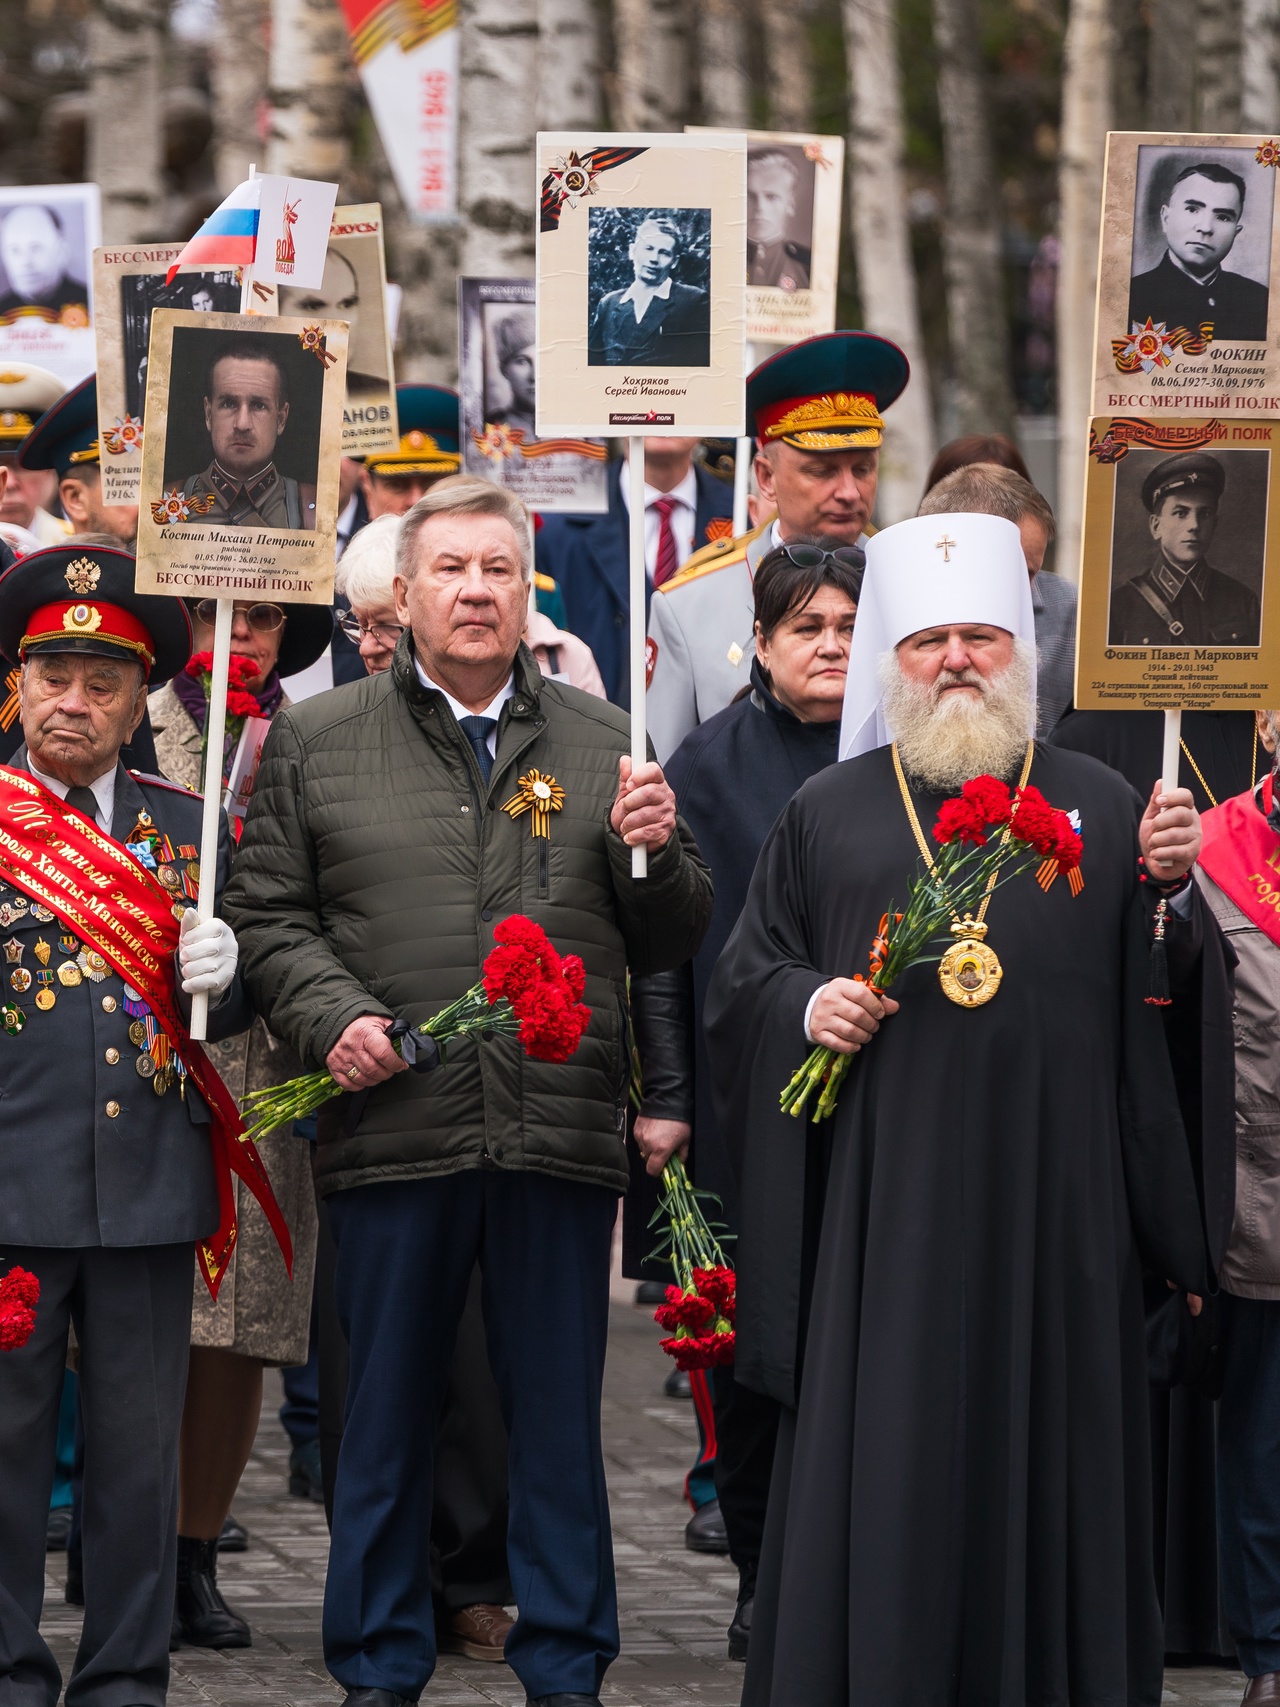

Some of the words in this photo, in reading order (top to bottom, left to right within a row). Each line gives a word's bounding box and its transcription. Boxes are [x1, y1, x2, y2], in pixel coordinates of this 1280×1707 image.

[276, 239, 287, 260] 80
[275, 262, 295, 275] ПОБЕДА!
[1210, 348, 1267, 361] ФОКИН
[1175, 363, 1209, 374] Семен
[1211, 365, 1266, 376] Маркович
[622, 376, 669, 387] Хохряков
[1151, 376, 1265, 389] 08.06.1927-30.09.1976
[605, 386, 638, 397] Сергей
[640, 387, 687, 396] Иванович
[1108, 393, 1230, 409] БЕССМЕРТНЫЙ
[1235, 397, 1280, 410] ПОЛК
[343, 405, 391, 423] АНОВ
[1114, 424, 1228, 440] БЕССМЕРТНЫЙ
[1232, 427, 1272, 440] ПОЛК
[160, 528, 204, 542] Костин
[208, 531, 253, 545] Михаил
[256, 534, 315, 548] Петрович
[221, 546, 251, 554] рядовой
[195, 554, 232, 563] 01.05.1900
[238, 556, 276, 565] 26.02.1942
[156, 572, 267, 590] БЕССМЕРТНЫЙ
[271, 578, 314, 592] ПОЛК
[1104, 649, 1147, 660] Фокин
[1151, 650, 1190, 660] Павел
[1193, 650, 1258, 663] Маркович
[1147, 664, 1166, 672] 1914
[1173, 664, 1214, 672] 29.01.1943
[1142, 673, 1177, 682] Старший
[1107, 683, 1150, 691] стрелковая
[1203, 683, 1248, 691] стрелковый
[1098, 691, 1137, 699] Командир
[1173, 692, 1221, 700] стрелкового
[1144, 700, 1181, 708] Операция
[32, 853, 160, 972] Ханты-Мансийска
